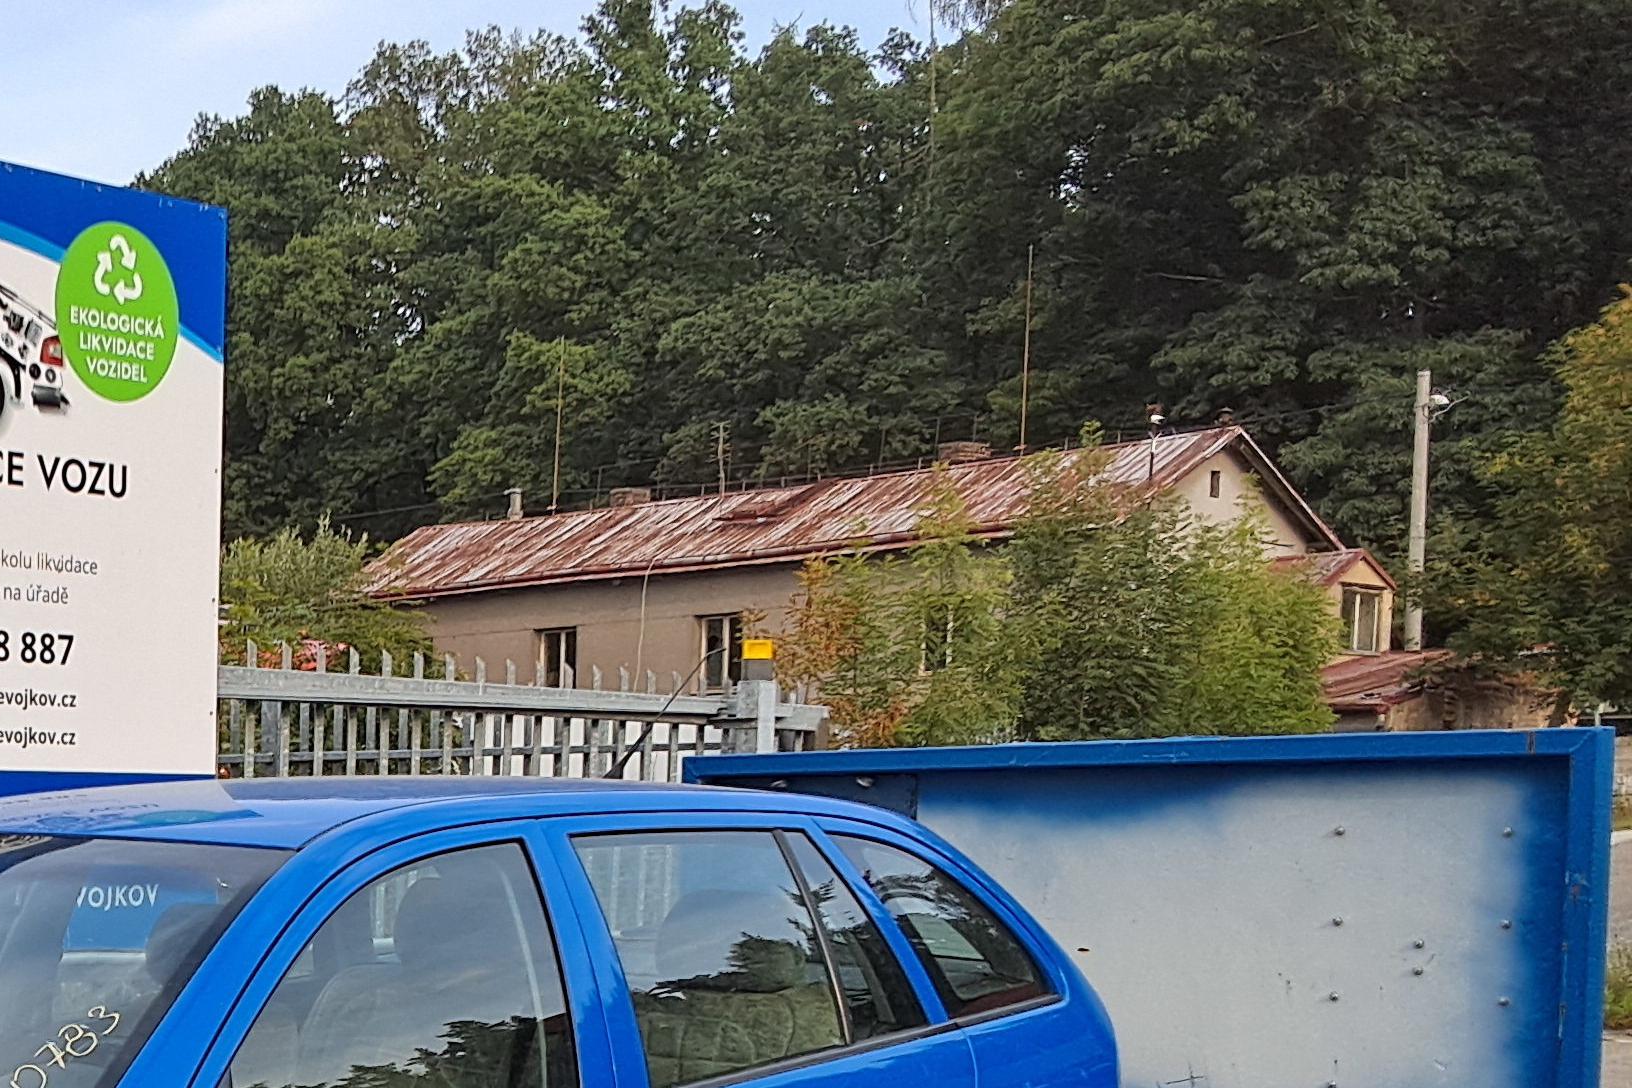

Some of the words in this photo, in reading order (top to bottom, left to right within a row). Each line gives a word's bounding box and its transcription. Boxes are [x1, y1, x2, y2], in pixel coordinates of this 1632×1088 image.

[70, 306, 165, 339] EKOLOGICKÁ
[79, 332, 155, 360] LIKVIDACE
[87, 357, 148, 383] VOZIDEL
[38, 454, 128, 498] VOZU
[37, 552, 98, 575] likvidace
[4, 585, 21, 602] na
[26, 584, 69, 605] úřadě
[20, 631, 74, 666] 887
